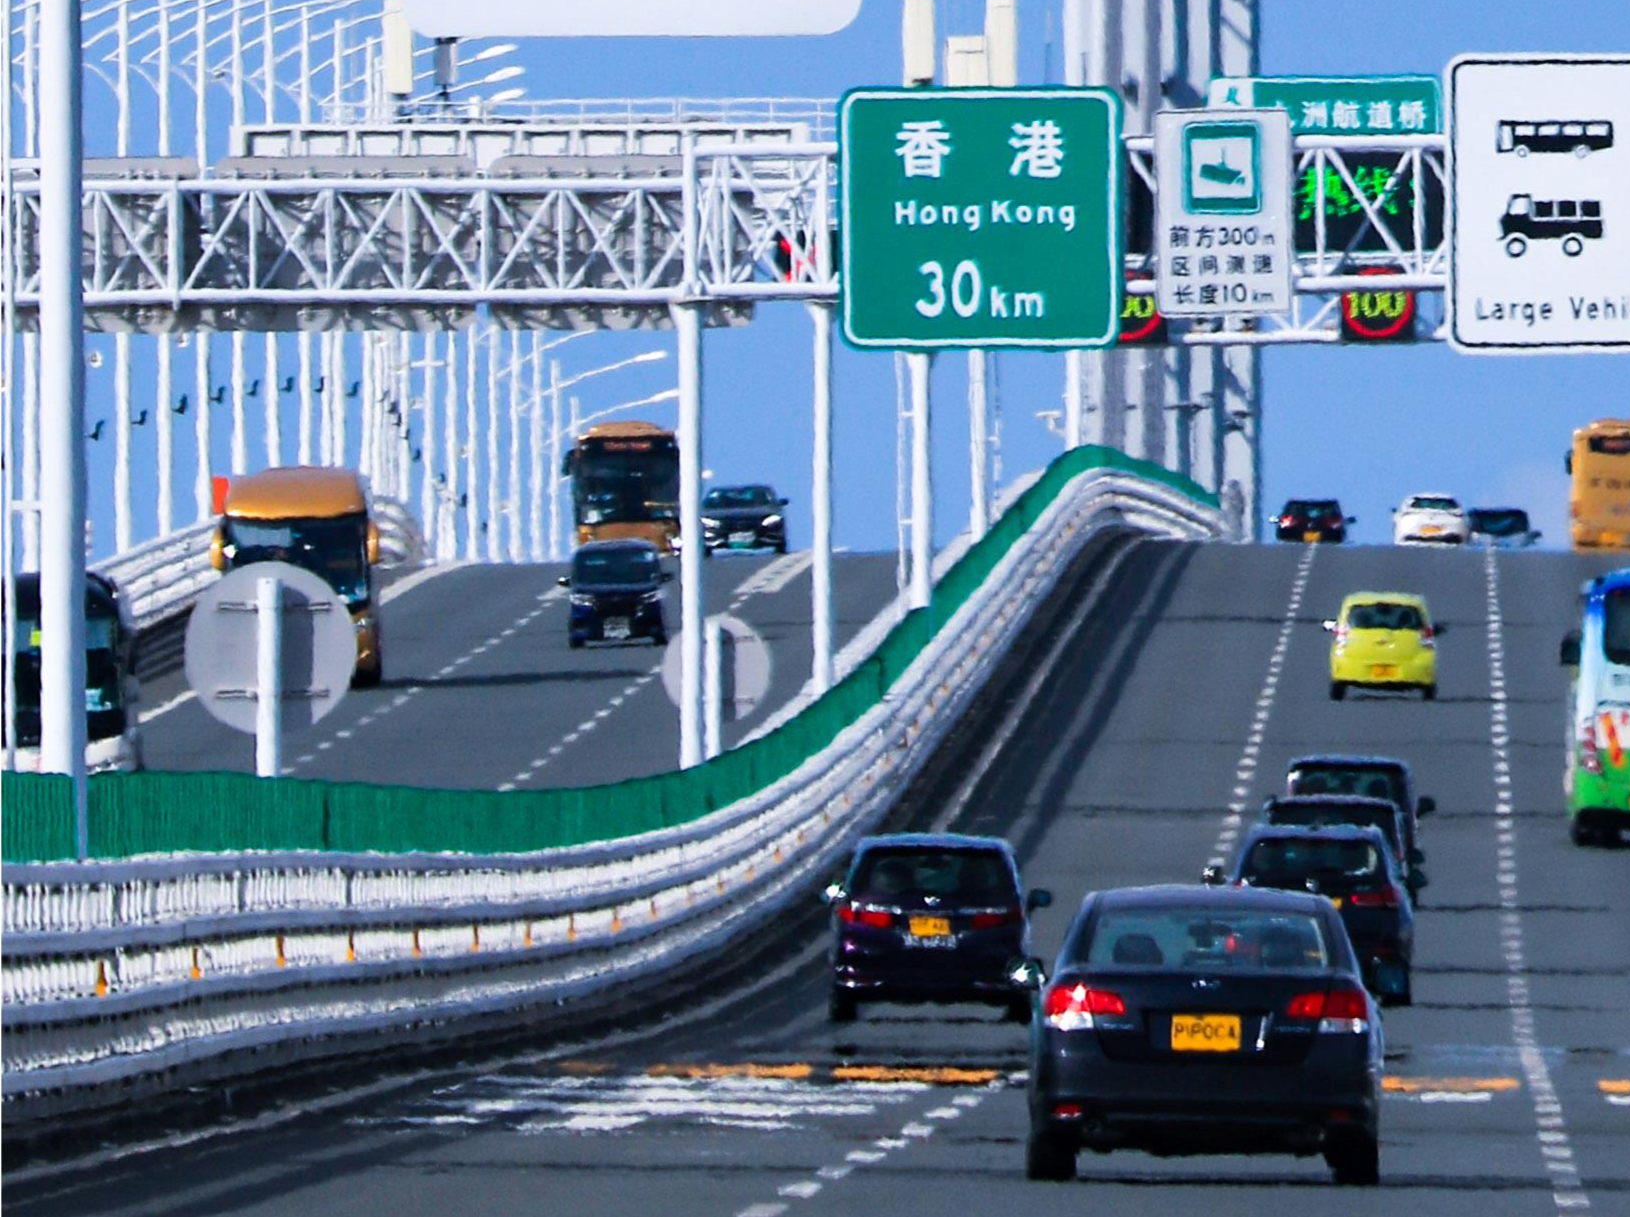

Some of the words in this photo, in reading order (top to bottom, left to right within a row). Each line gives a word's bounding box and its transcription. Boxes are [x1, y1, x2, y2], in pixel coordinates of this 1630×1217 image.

[1277, 100, 1427, 129] 洲航道桥
[894, 120, 1065, 178] 香港
[894, 200, 981, 231] Hong
[990, 200, 1076, 231] Kong
[1348, 291, 1407, 319] 100
[1475, 296, 1553, 326] Large
